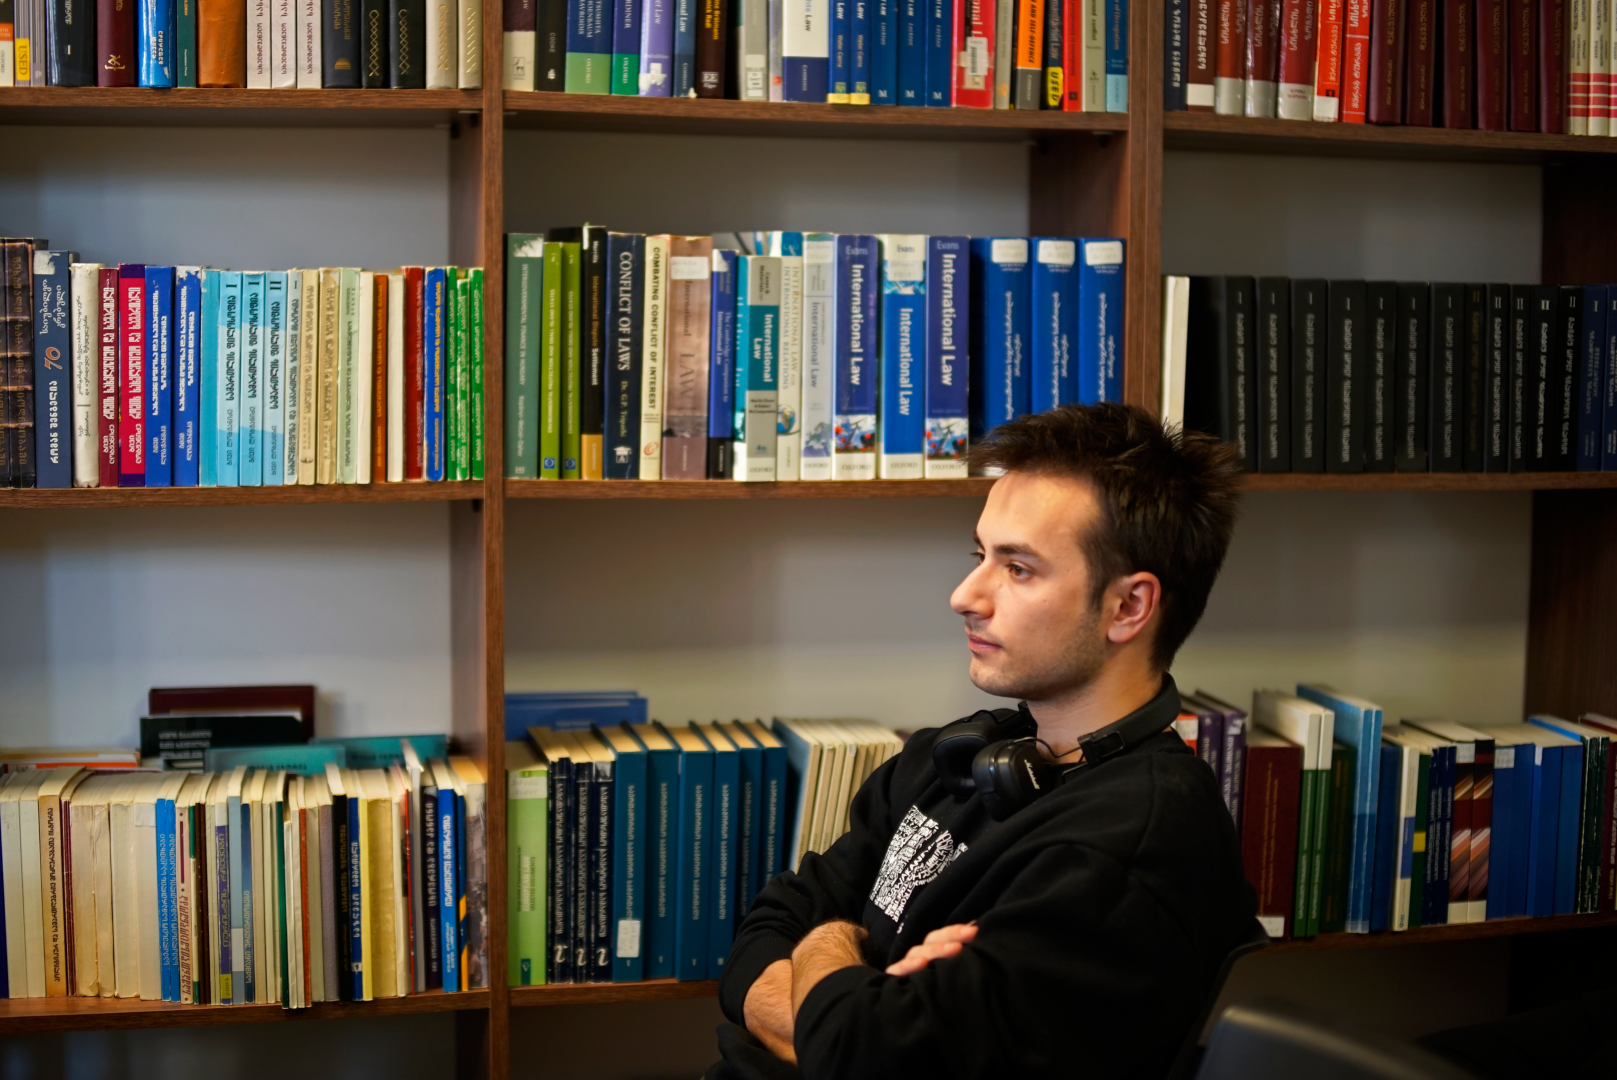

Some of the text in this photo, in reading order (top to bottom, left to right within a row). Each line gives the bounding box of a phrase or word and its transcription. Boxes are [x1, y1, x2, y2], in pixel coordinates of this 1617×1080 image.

[654, 9, 663, 24] Law
[679, 18, 688, 32] Law
[857, 3, 865, 19] Law
[18, 46, 27, 75] USED
[1028, 19, 1036, 63] SELF-DEFENCE
[1050, 43, 1059, 59] Law
[846, 245, 869, 256] Evans
[896, 245, 915, 253] Evans
[936, 240, 960, 250] Evans
[618, 251, 633, 315] CONFLICT
[39, 279, 52, 335] საიუბილეო
[56, 285, 66, 329] კრებული
[103, 287, 115, 329] სამართალი
[129, 287, 142, 329] სამართალი
[618, 317, 631, 336] OF
[791, 266, 800, 347] INTERNATIONAL
[849, 264, 864, 385] International Law
[940, 253, 957, 386] International Law
[103, 333, 115, 343] და
[129, 333, 141, 343] და
[152, 340, 159, 351] და
[179, 335, 186, 346] და
[226, 295, 236, 401] სამართლის ფილოსოფია
[248, 293, 258, 398] სამართლის ფილოსოფია
[648, 246, 660, 410] COMBATING CONFLICT OF INTEREST
[716, 311, 724, 352] International
[754, 338, 763, 359] Law
[763, 314, 774, 382] International
[810, 302, 820, 388] International Law
[44, 346, 63, 370] 70
[270, 302, 280, 409] სამართლის ფილოსოფია
[617, 338, 631, 371] LAWS
[678, 352, 695, 398] LAW
[782, 342, 790, 390] RELATIONS
[899, 308, 913, 416] International Law
[49, 380, 58, 463] რომან შენგელია
[289, 410, 296, 419] და
[425, 802, 438, 907] ცხოვრება და კანონი
[351, 841, 360, 938] საზღვაო სამართალი
[522, 856, 531, 912] EUROPEAN LAW
[53, 934, 59, 943] და
